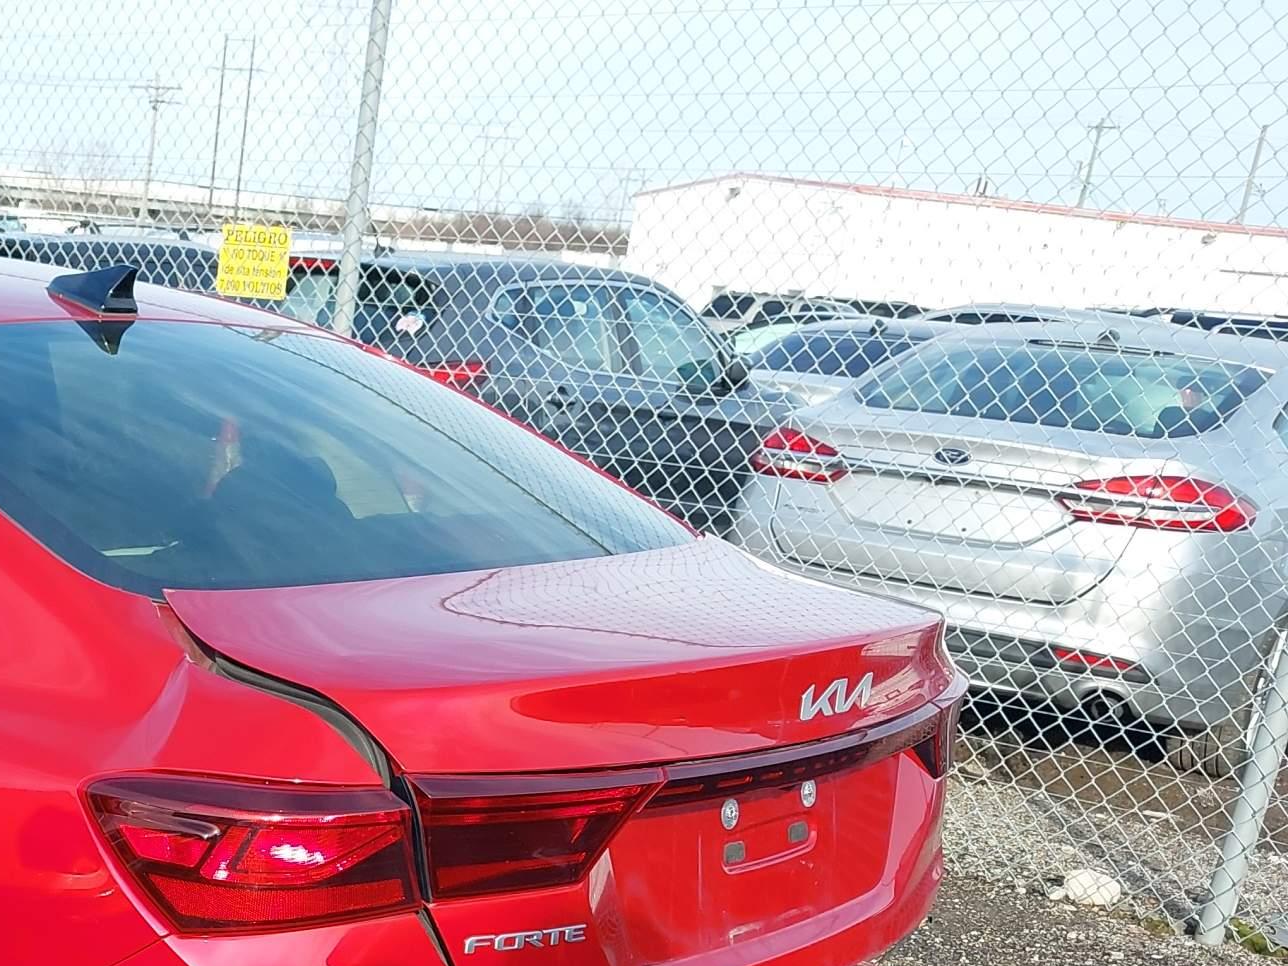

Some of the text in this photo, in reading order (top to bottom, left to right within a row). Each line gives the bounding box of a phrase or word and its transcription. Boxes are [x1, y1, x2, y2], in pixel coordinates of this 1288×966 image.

[224, 229, 289, 246] PELIGRO
[799, 671, 874, 722] KIA
[463, 922, 588, 955] FORTE
